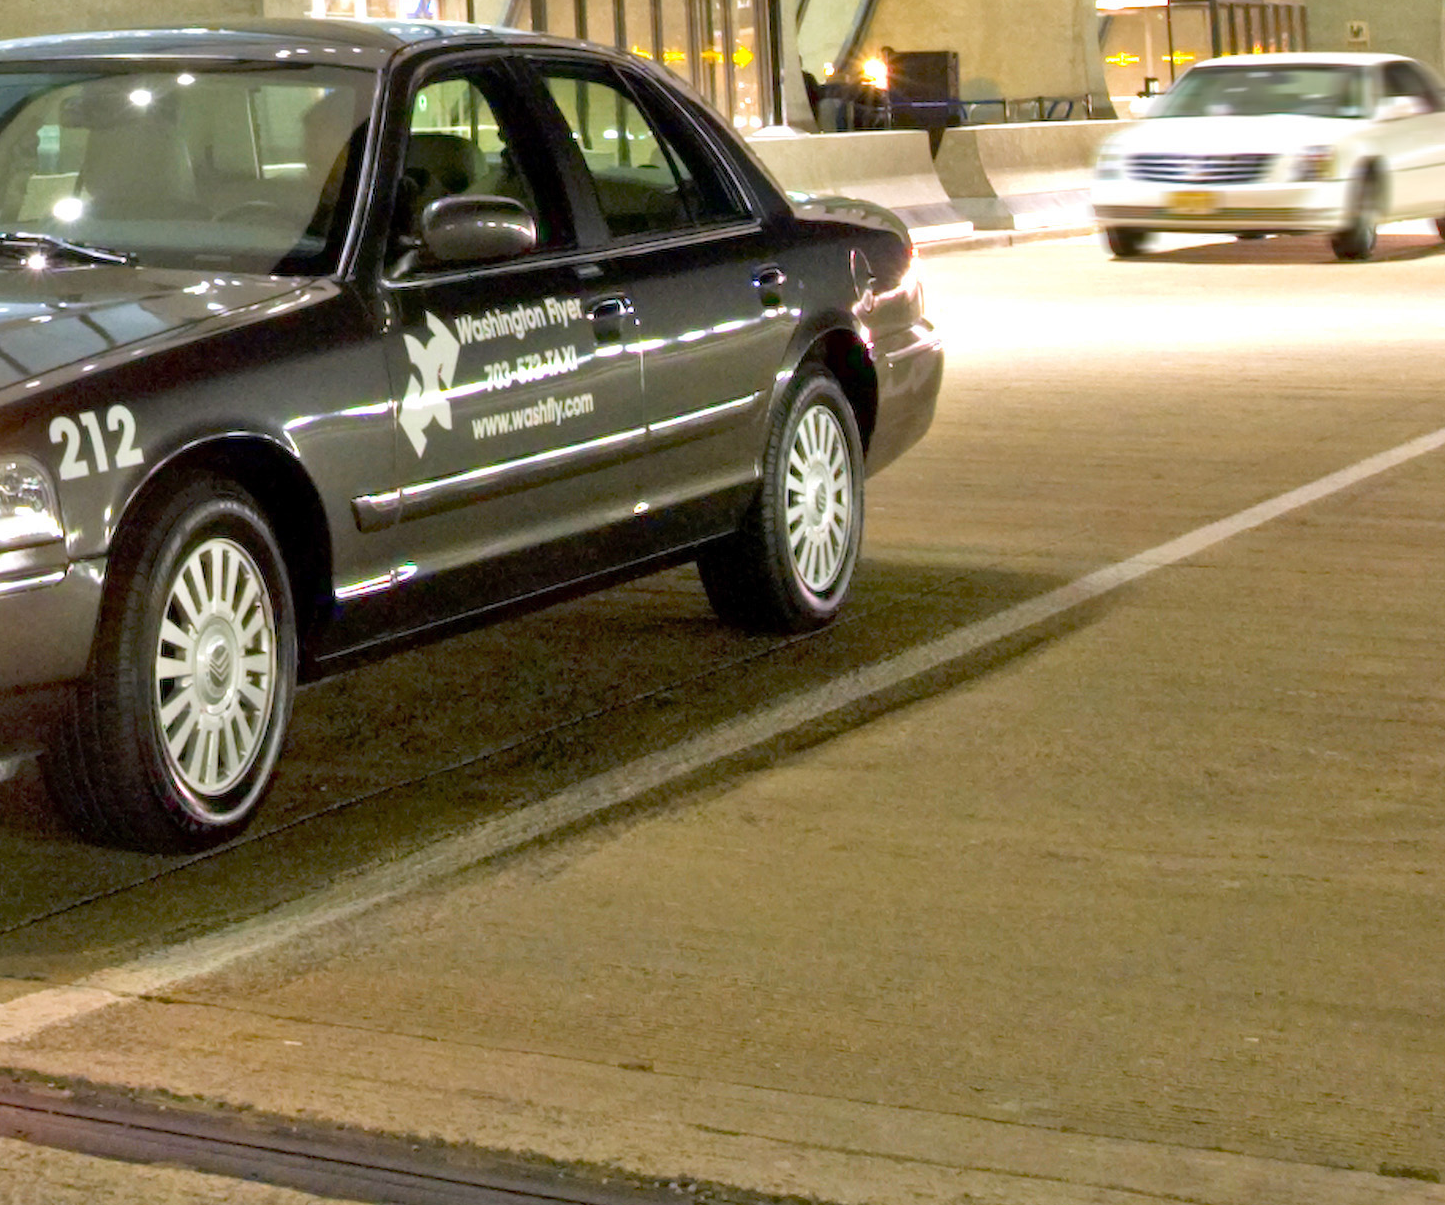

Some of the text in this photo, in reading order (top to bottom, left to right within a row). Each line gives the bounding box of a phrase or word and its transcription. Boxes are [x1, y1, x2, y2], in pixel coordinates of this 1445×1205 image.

[455, 297, 582, 344] Washington Flyer
[472, 393, 594, 440] www.washfly.com
[49, 404, 144, 481] 212
